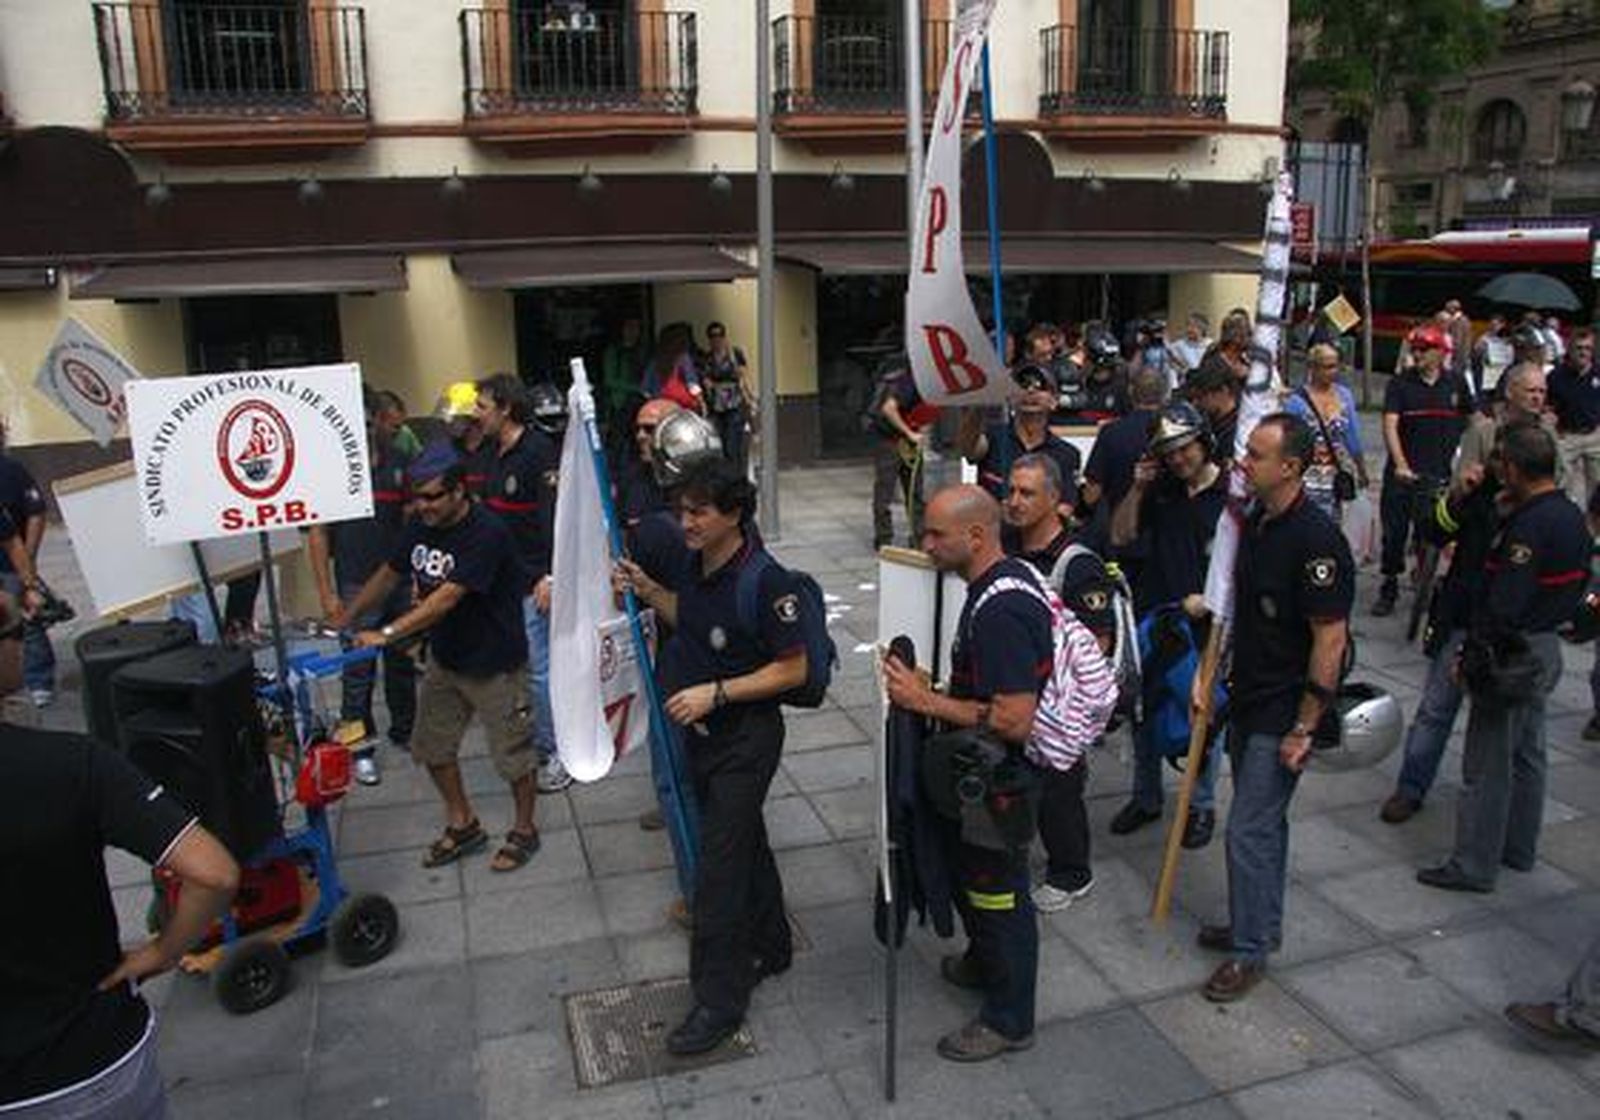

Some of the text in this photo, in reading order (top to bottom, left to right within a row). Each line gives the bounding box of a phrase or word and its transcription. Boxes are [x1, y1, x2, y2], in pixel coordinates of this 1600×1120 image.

[145, 421, 178, 518] SINDICATO
[171, 374, 296, 423] PROFESIONAL
[300, 388, 324, 410] DE
[322, 405, 363, 496] BOMBEROS
[222, 501, 318, 530] S.P.B.
